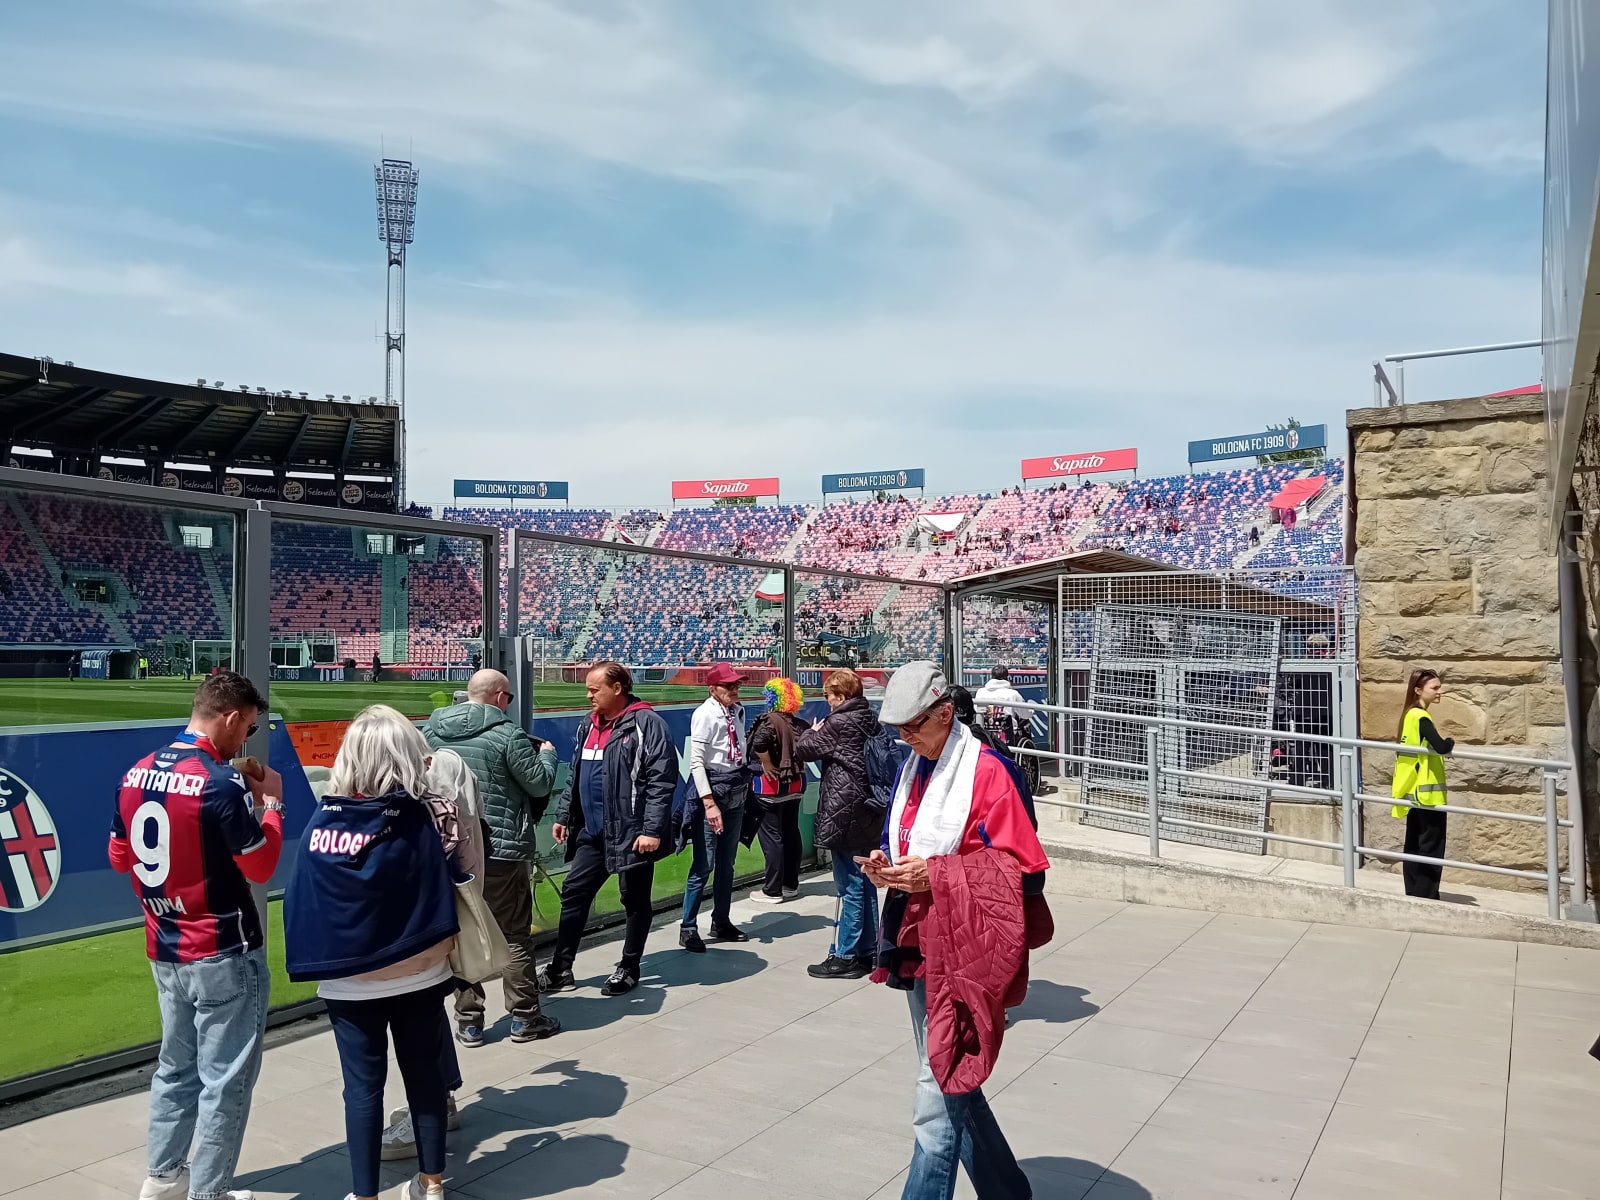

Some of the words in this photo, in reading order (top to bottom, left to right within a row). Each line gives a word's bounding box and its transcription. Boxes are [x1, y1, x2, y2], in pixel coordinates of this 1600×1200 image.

[1212, 440, 1250, 456] BOLOGNA
[1251, 438, 1262, 450] FC
[1264, 435, 1284, 449] 1909
[1050, 454, 1106, 474] Saputo
[183, 479, 214, 490] Selenella
[838, 477, 868, 488] BOLOGNA
[869, 476, 878, 486] FC
[879, 474, 895, 486] 1909
[246, 484, 276, 494] Selenella
[475, 483, 507, 494] BOLOGNA
[508, 484, 517, 494] FC
[518, 484, 536, 495] 1909
[701, 481, 750, 497] Saputo
[273, 668, 282, 680] FC
[284, 668, 300, 680] 1909
[411, 669, 439, 681] SCARICA
[123, 767, 205, 797] SANTANDER
[130, 800, 171, 888] 9
